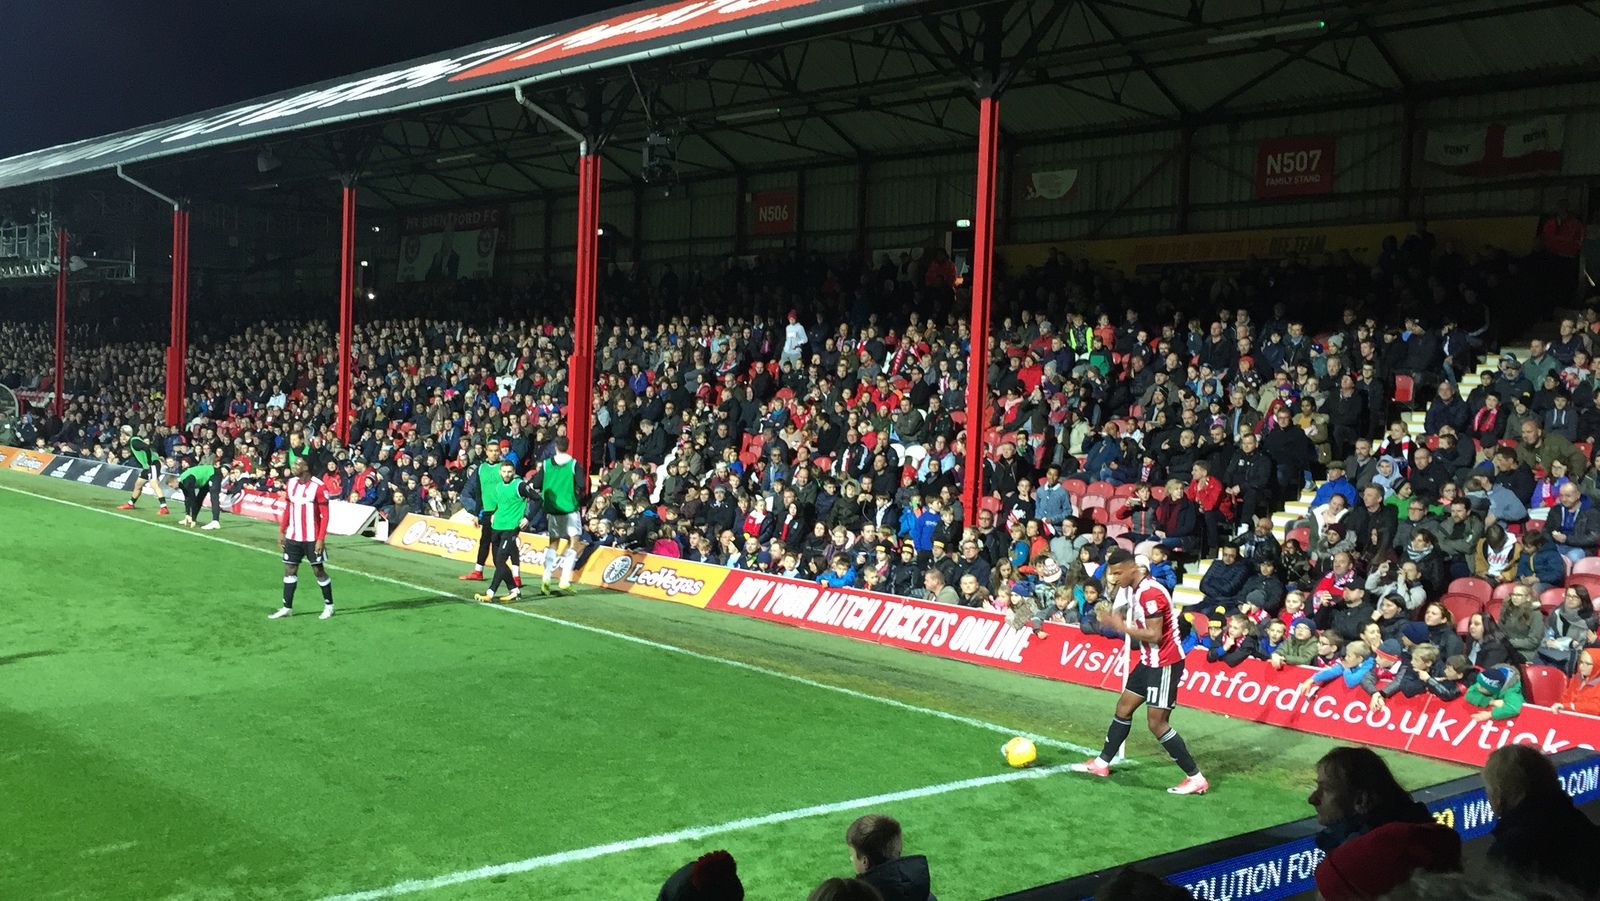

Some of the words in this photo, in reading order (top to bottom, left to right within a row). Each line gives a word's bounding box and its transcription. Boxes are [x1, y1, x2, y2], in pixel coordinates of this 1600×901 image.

[1266, 149, 1322, 176] N507
[1265, 177, 1294, 187] FAMILY
[1295, 175, 1321, 185] STAND
[483, 209, 500, 223] FC
[760, 205, 788, 223] N506
[419, 526, 478, 553] LeoVegas
[626, 562, 705, 596] LeoVegas
[727, 576, 777, 610] BUY
[763, 582, 820, 620] YOUR
[806, 590, 883, 632] MATCH
[869, 601, 959, 647] TICKETS
[948, 616, 1034, 663] ONLINE
[1146, 686, 1159, 703] 11
